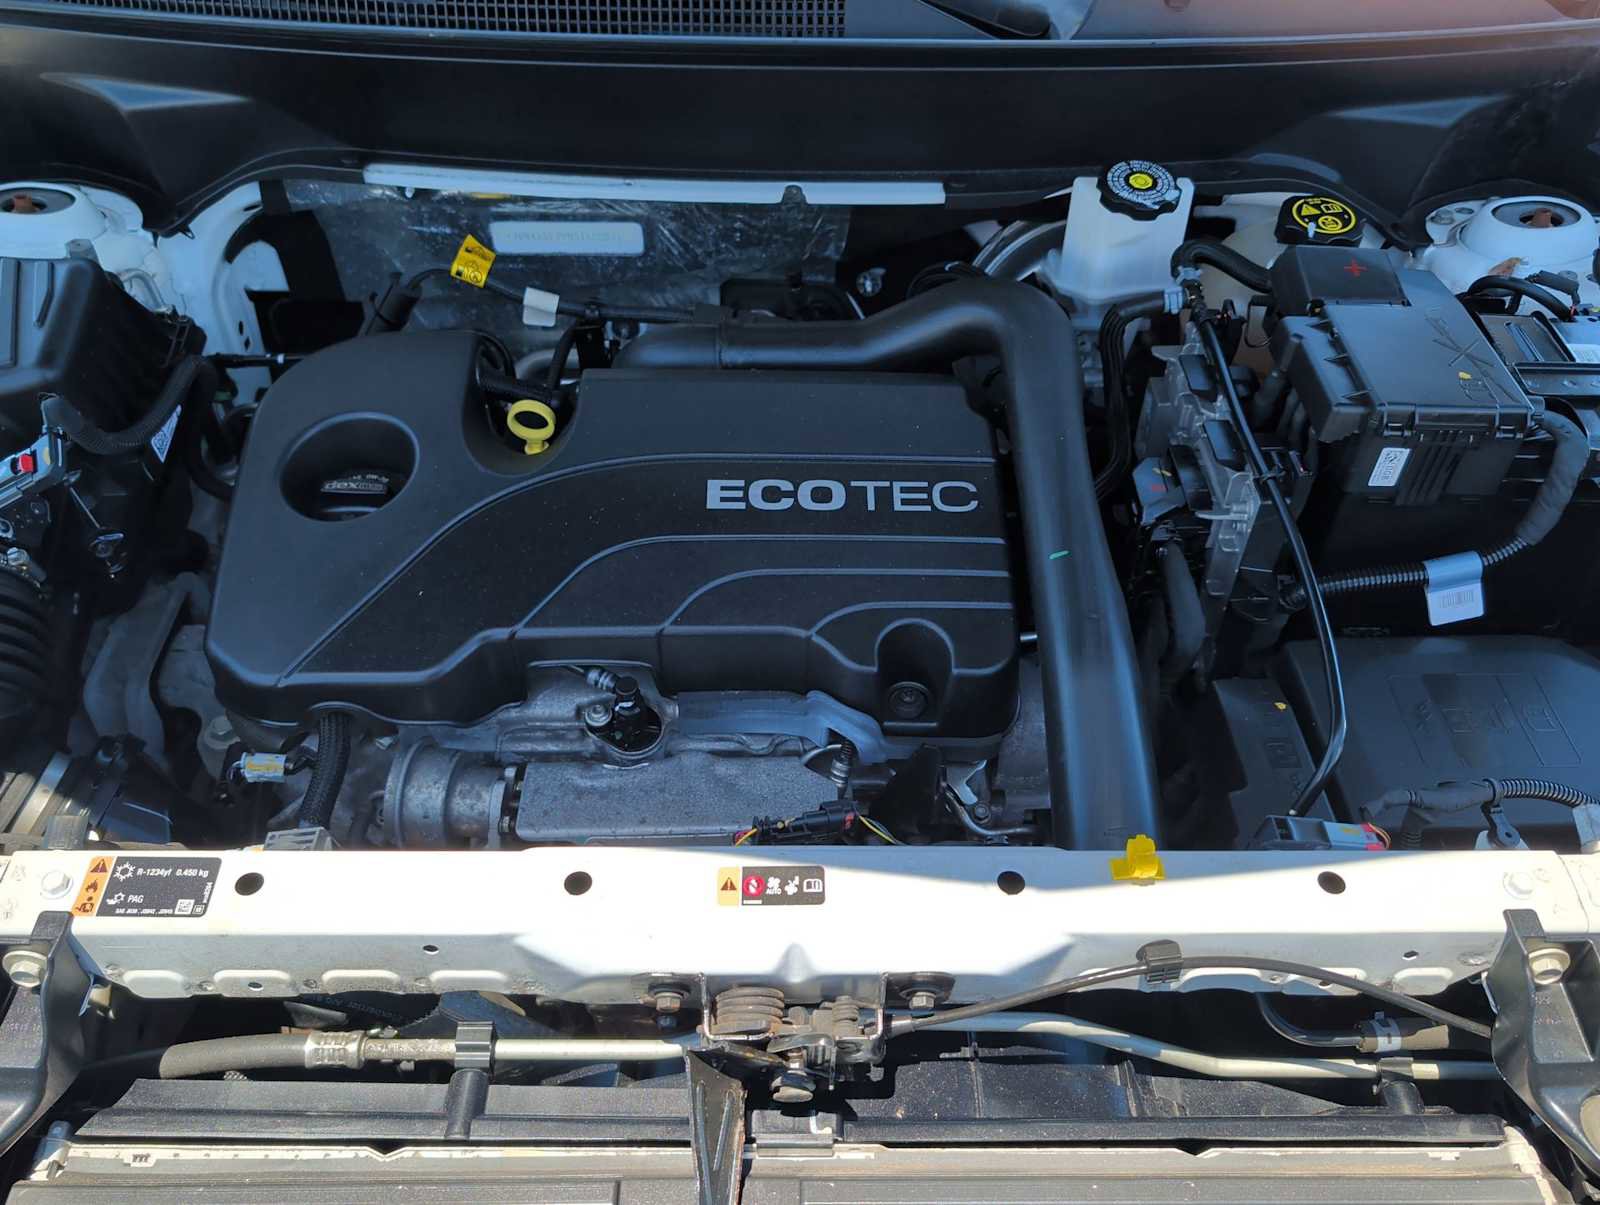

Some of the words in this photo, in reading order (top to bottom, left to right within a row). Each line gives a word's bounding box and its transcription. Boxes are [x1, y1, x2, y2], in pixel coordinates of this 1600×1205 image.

[706, 479, 979, 512] ECOTEC
[136, 868, 171, 877] R-1234yf
[175, 868, 198, 877] 0.450
[198, 869, 209, 878] kg
[127, 894, 145, 903] PAG
